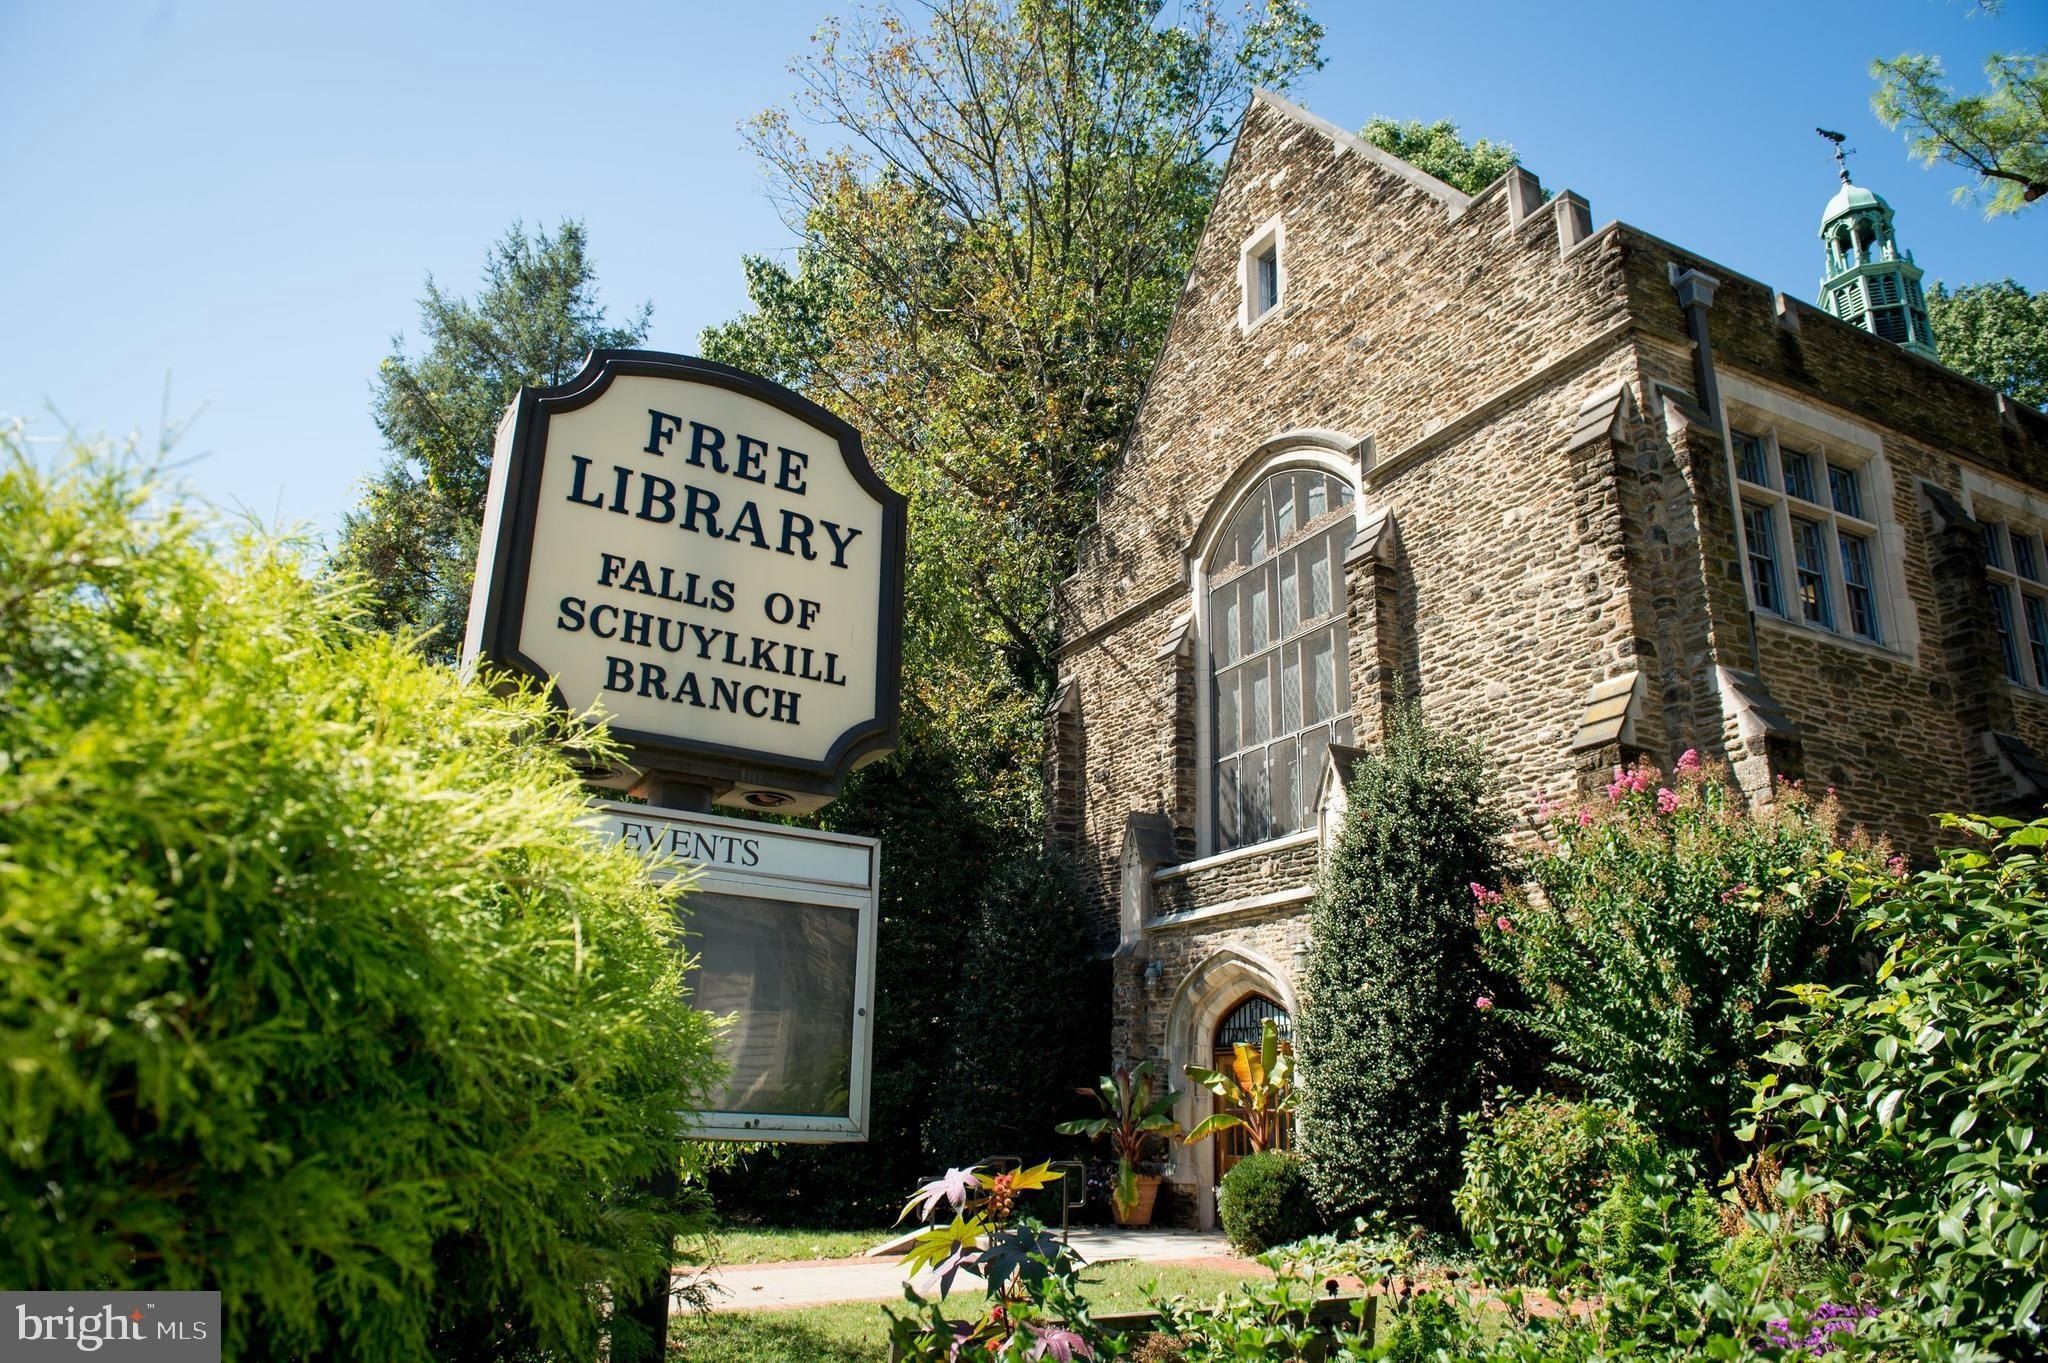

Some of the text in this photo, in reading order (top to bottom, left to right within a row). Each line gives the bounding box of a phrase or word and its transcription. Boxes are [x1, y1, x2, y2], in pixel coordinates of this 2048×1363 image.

[643, 408, 809, 497] FREE
[566, 454, 863, 570] LIBRARY
[597, 552, 822, 631] FALLS OF
[557, 596, 848, 687] SCHUYLKILL
[602, 655, 802, 726] BRANCH
[620, 821, 760, 867] EVENTS
